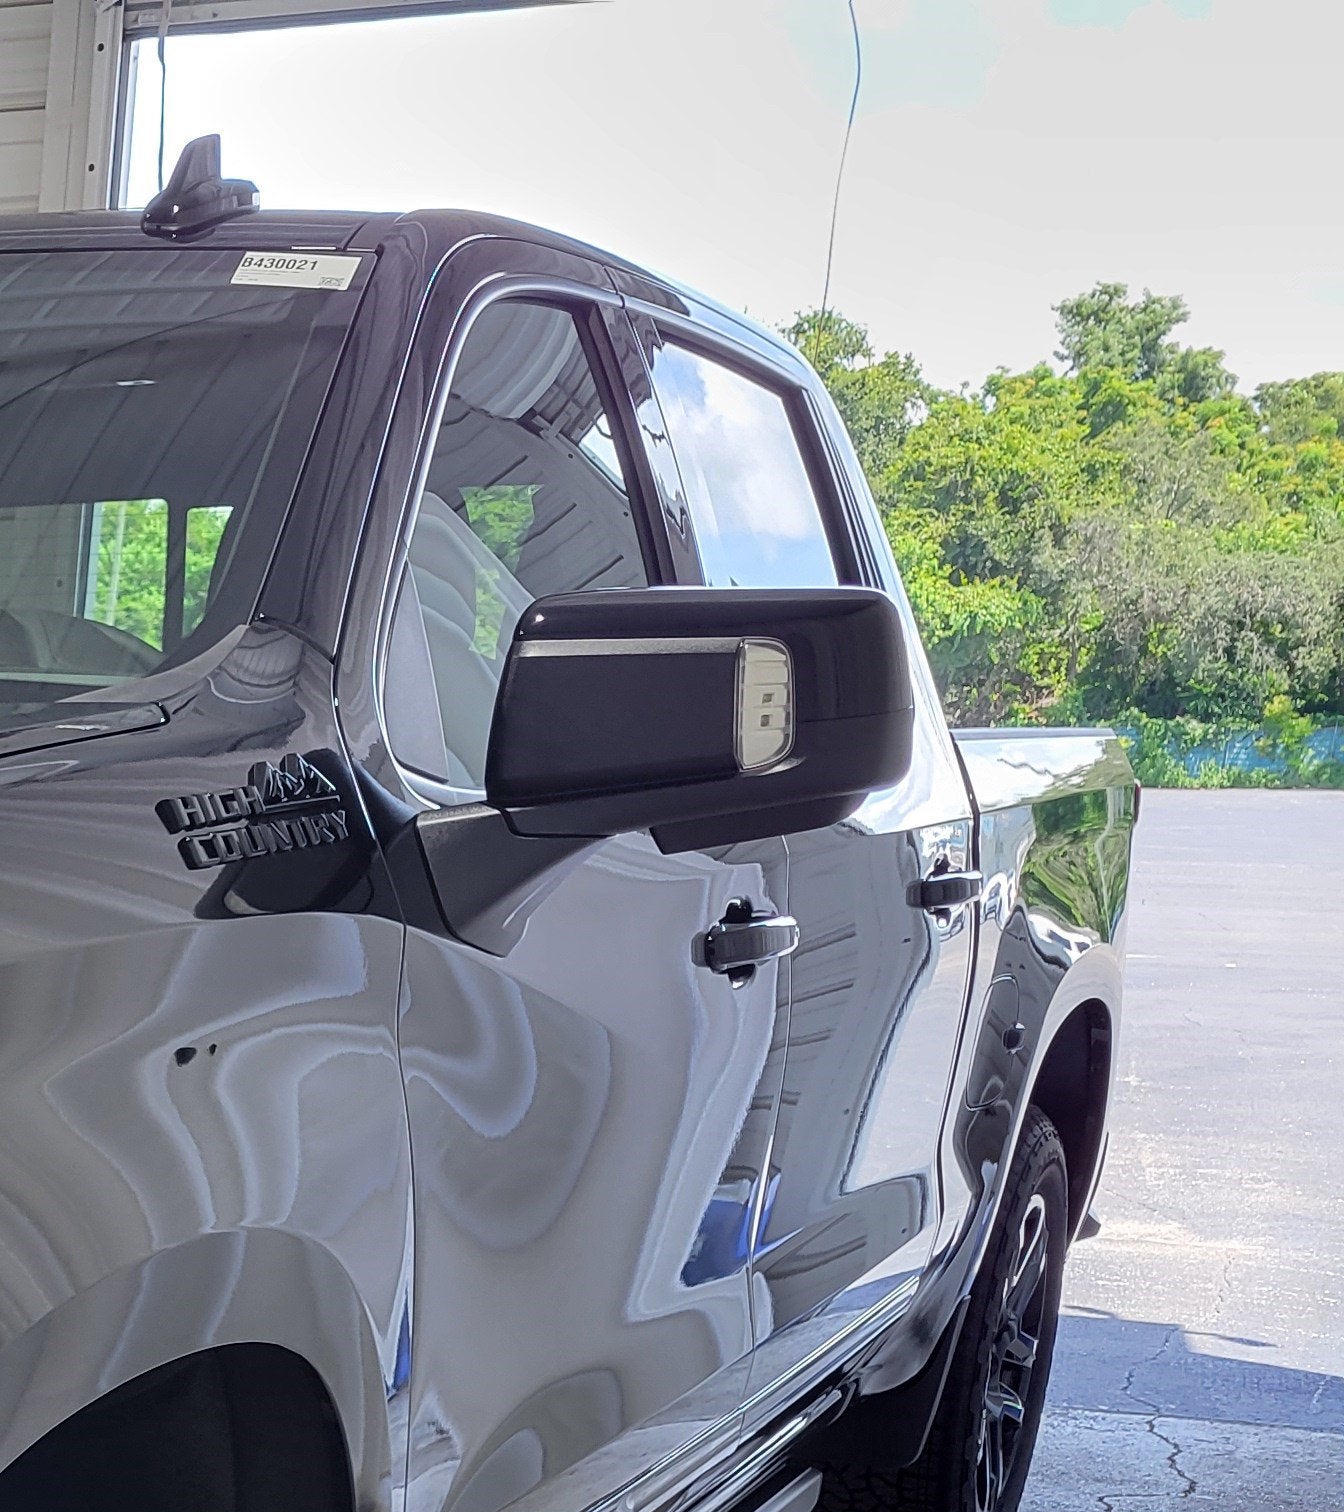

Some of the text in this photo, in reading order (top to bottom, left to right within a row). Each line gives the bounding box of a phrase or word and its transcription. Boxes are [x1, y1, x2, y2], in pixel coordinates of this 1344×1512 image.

[241, 257, 318, 271] B430021
[155, 785, 266, 834] HIGH
[177, 809, 350, 870] COUNTRY
